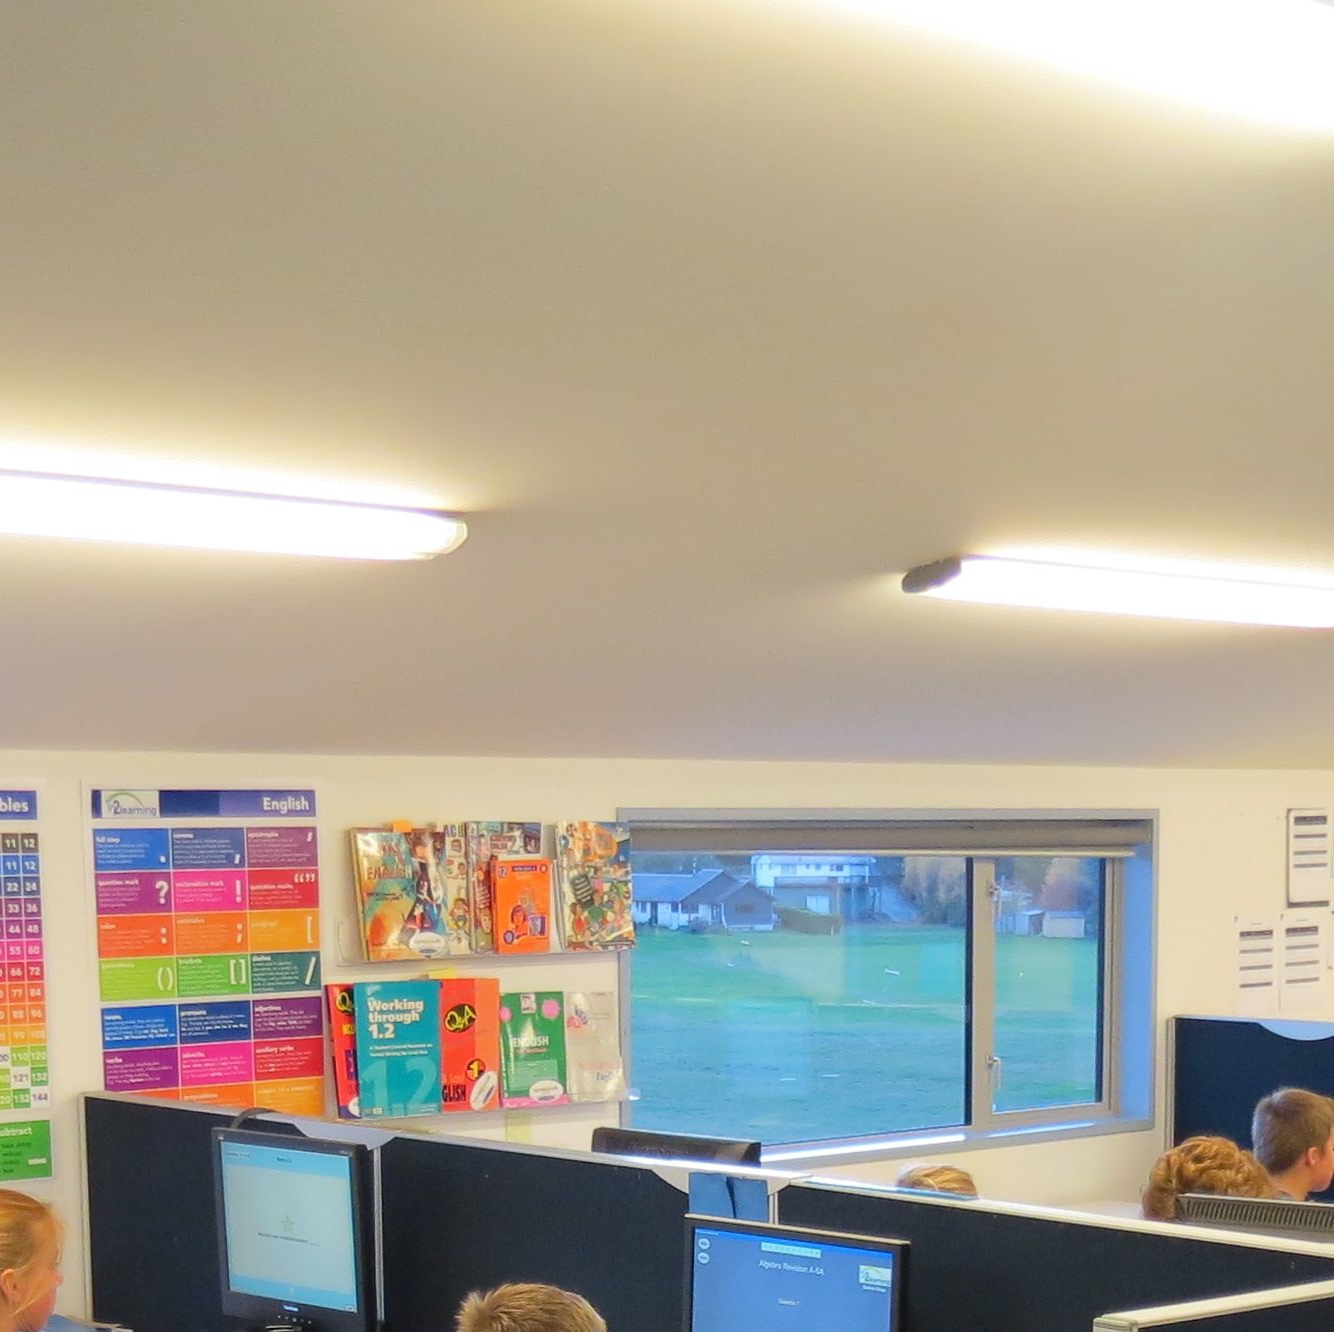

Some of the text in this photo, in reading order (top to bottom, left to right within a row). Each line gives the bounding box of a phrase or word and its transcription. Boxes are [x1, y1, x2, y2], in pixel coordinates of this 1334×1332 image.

[262, 797, 310, 814] English
[4, 838, 16, 848] 11
[23, 838, 35, 848] 12
[5, 860, 17, 870] 11
[24, 860, 36, 870] 12
[6, 881, 18, 892] 22
[25, 881, 37, 891] 24
[7, 903, 19, 913] 33
[26, 902, 38, 912] 36
[367, 999, 424, 1012] Working
[368, 1011, 420, 1025] through
[368, 1023, 395, 1039] 1.2
[758, 1259, 782, 1272] Algebra
